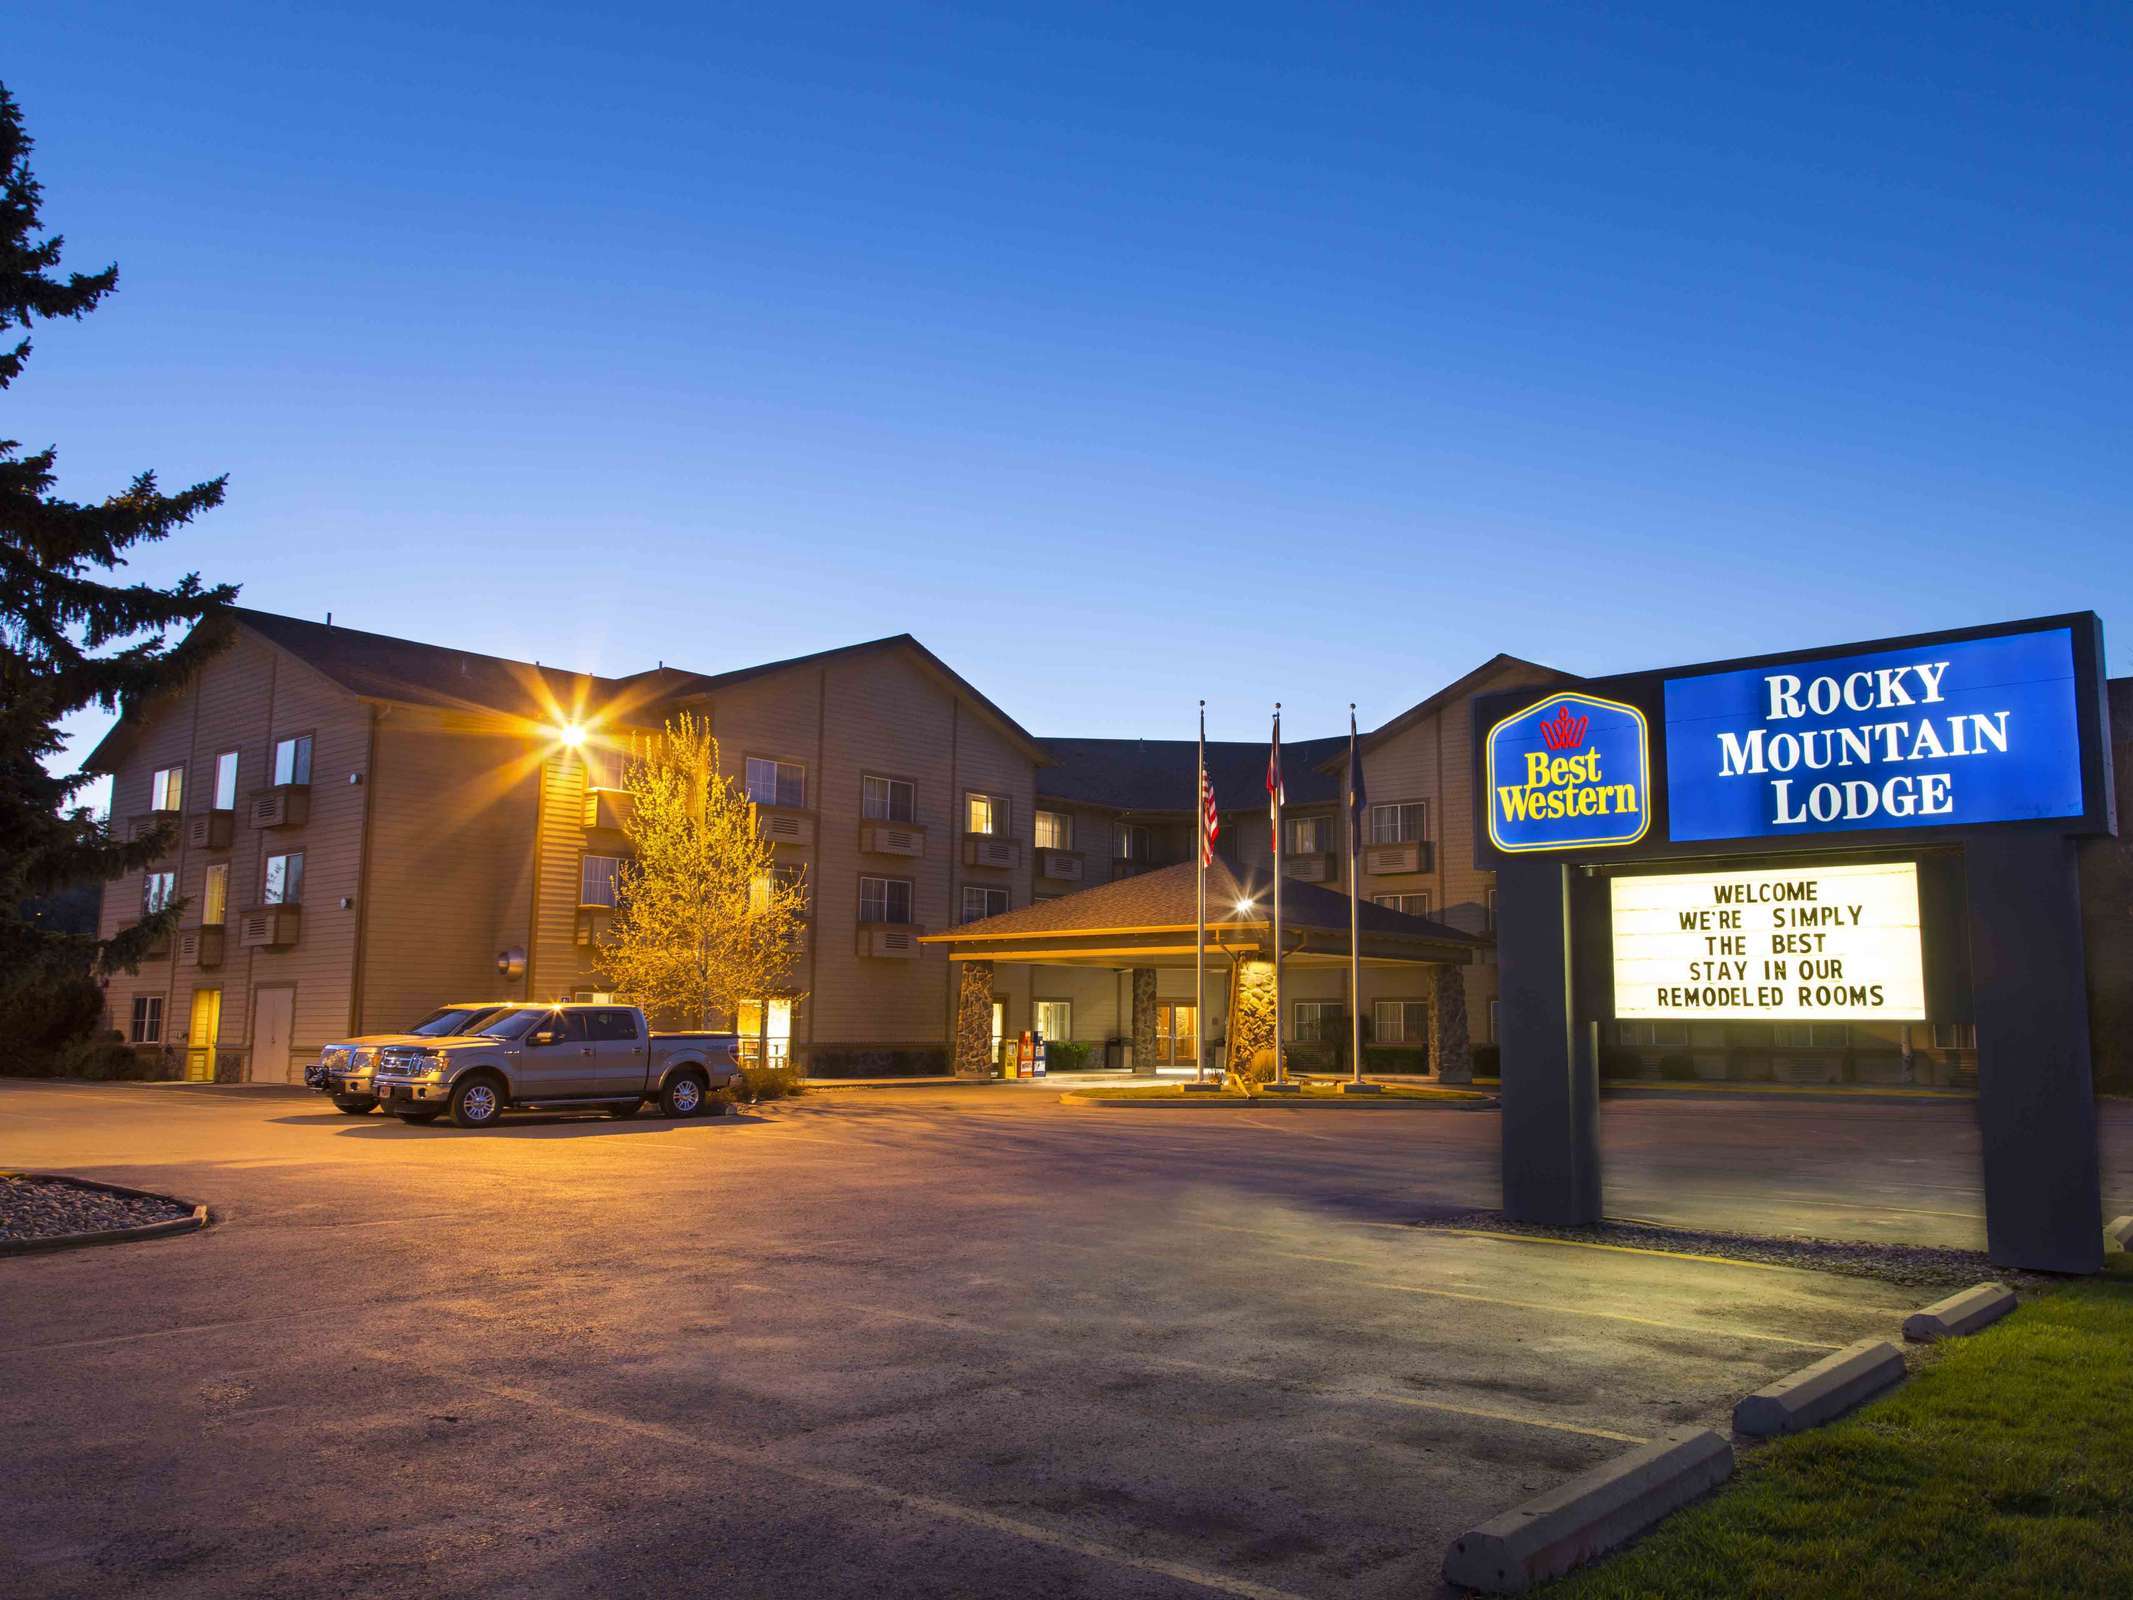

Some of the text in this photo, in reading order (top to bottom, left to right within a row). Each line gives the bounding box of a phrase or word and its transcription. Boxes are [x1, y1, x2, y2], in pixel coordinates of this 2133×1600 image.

[1764, 661, 1950, 720] ROCKY
[1717, 710, 2011, 777] MOUNTAIN
[1524, 746, 1602, 788] Best
[1497, 773, 1639, 822] Western
[1770, 773, 1953, 825] LODGE
[1713, 881, 1818, 904] WELCOME
[1679, 905, 1863, 931] WE'RE SIMPLY
[1705, 933, 1826, 956] THE BEST
[1689, 959, 1843, 981] STAY IN OUR
[1657, 985, 1884, 1007] REMODELED ROOMS
